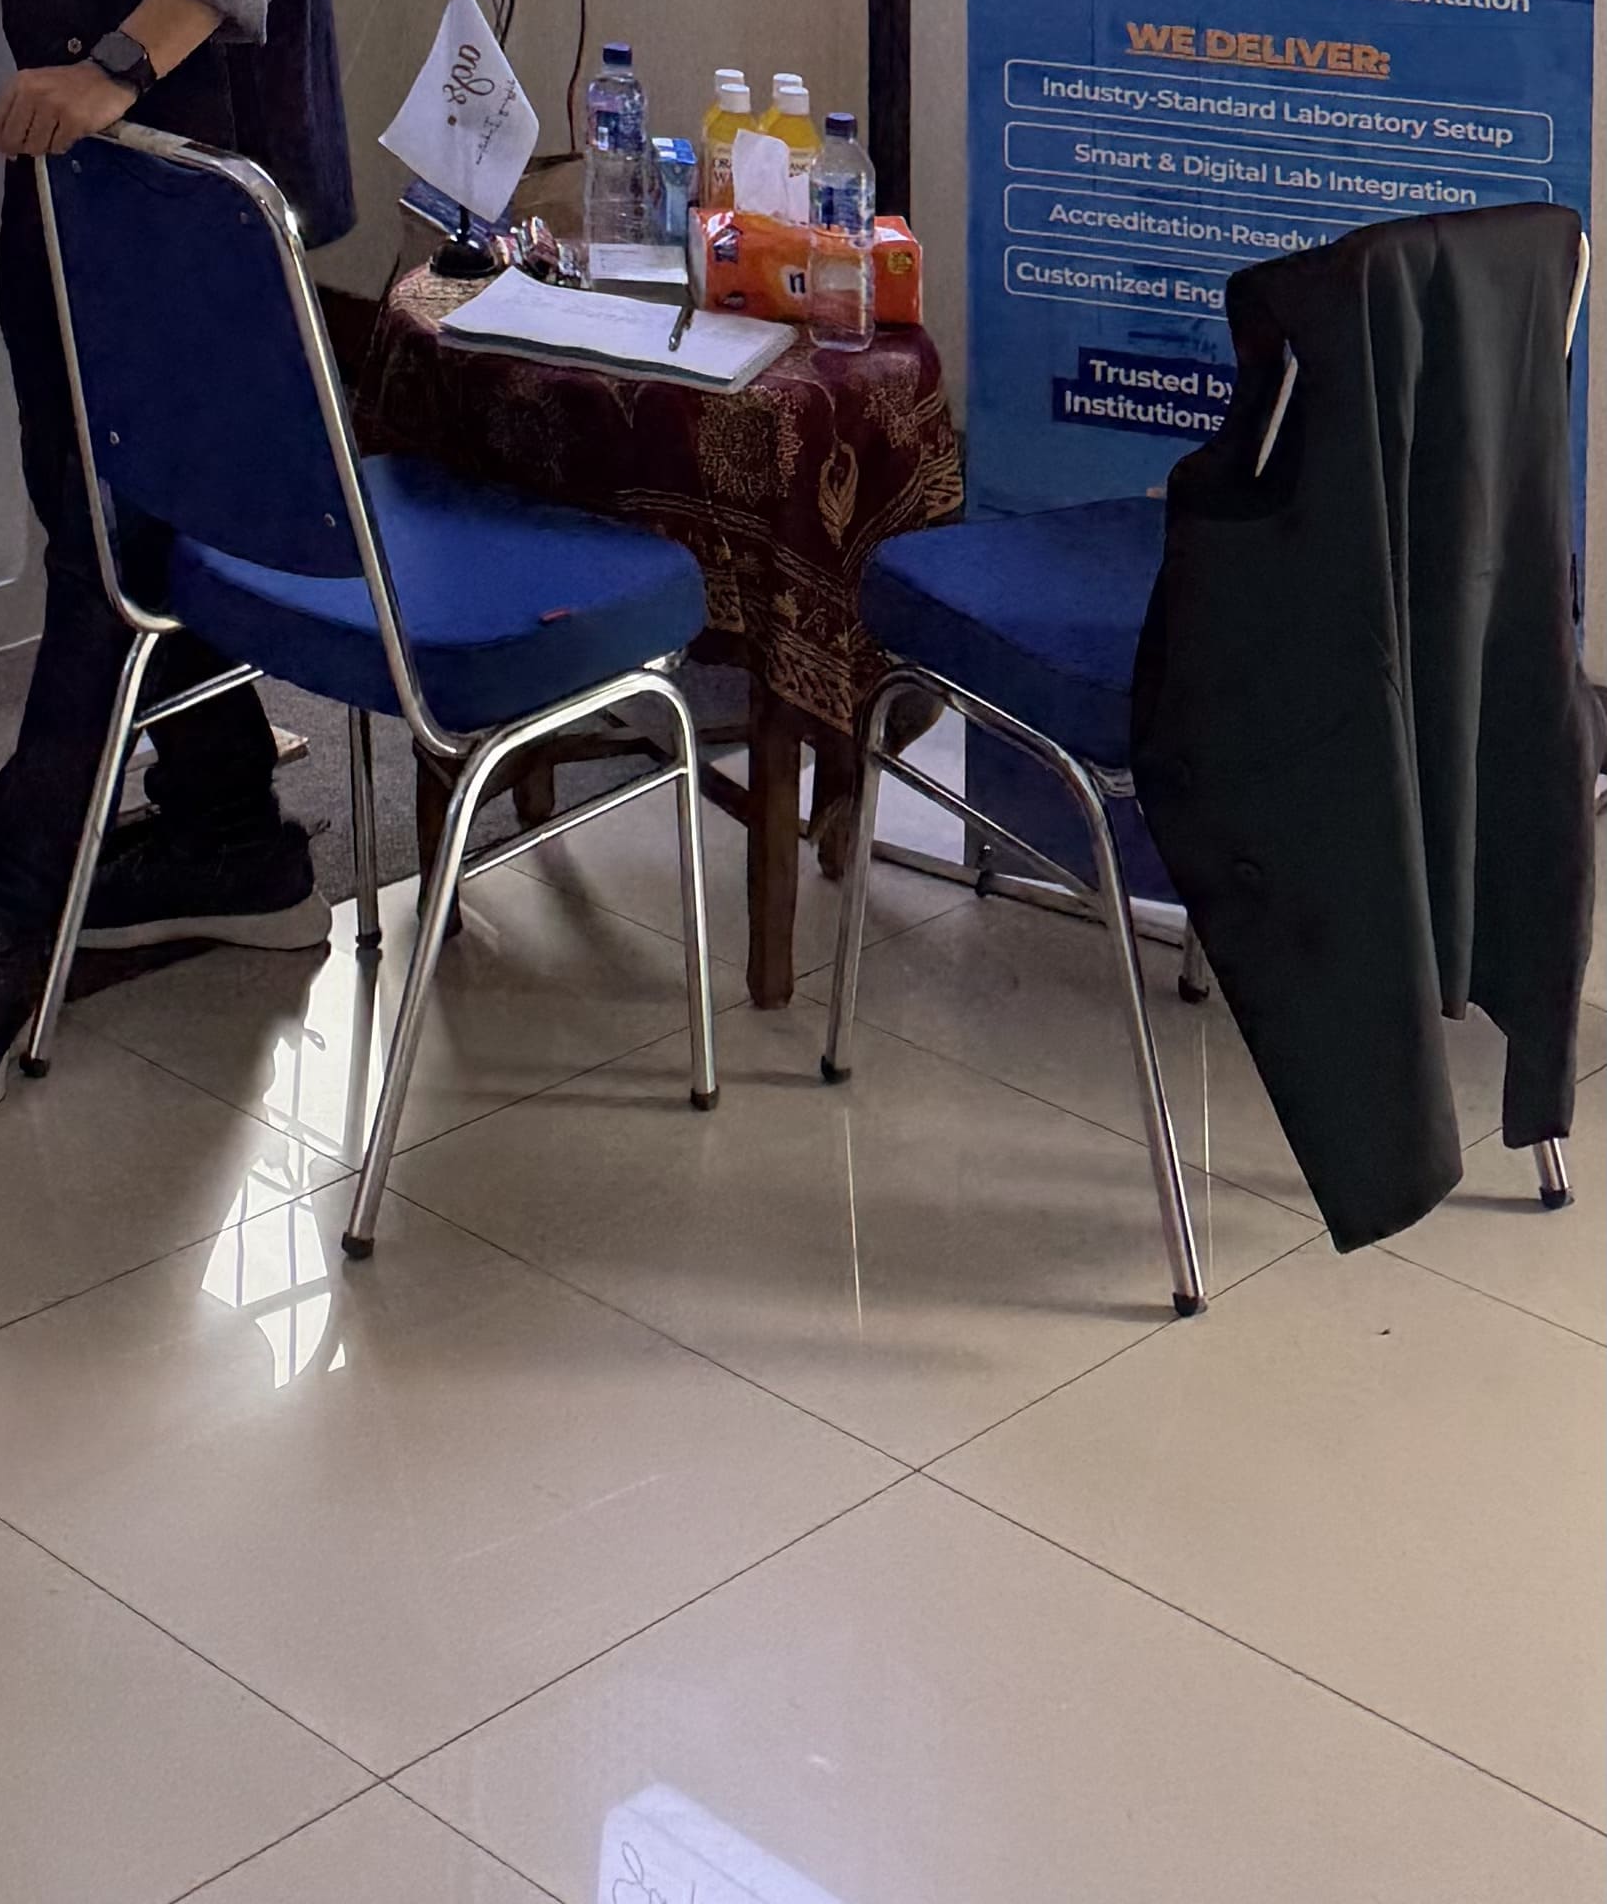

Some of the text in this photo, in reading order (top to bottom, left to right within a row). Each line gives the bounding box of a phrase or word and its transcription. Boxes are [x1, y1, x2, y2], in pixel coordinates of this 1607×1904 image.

[1126, 21, 1391, 76] WE DELIVER:
[1042, 76, 1514, 148] Industry-Standard Laboratory Setup
[1074, 143, 1478, 206] Smart & Digital Lab Integration
[1048, 203, 1314, 252] Accreditation-Ready
[1016, 261, 1168, 299] Customized
[1089, 358, 1199, 396] Trusted
[1064, 390, 1226, 432] Institutions
